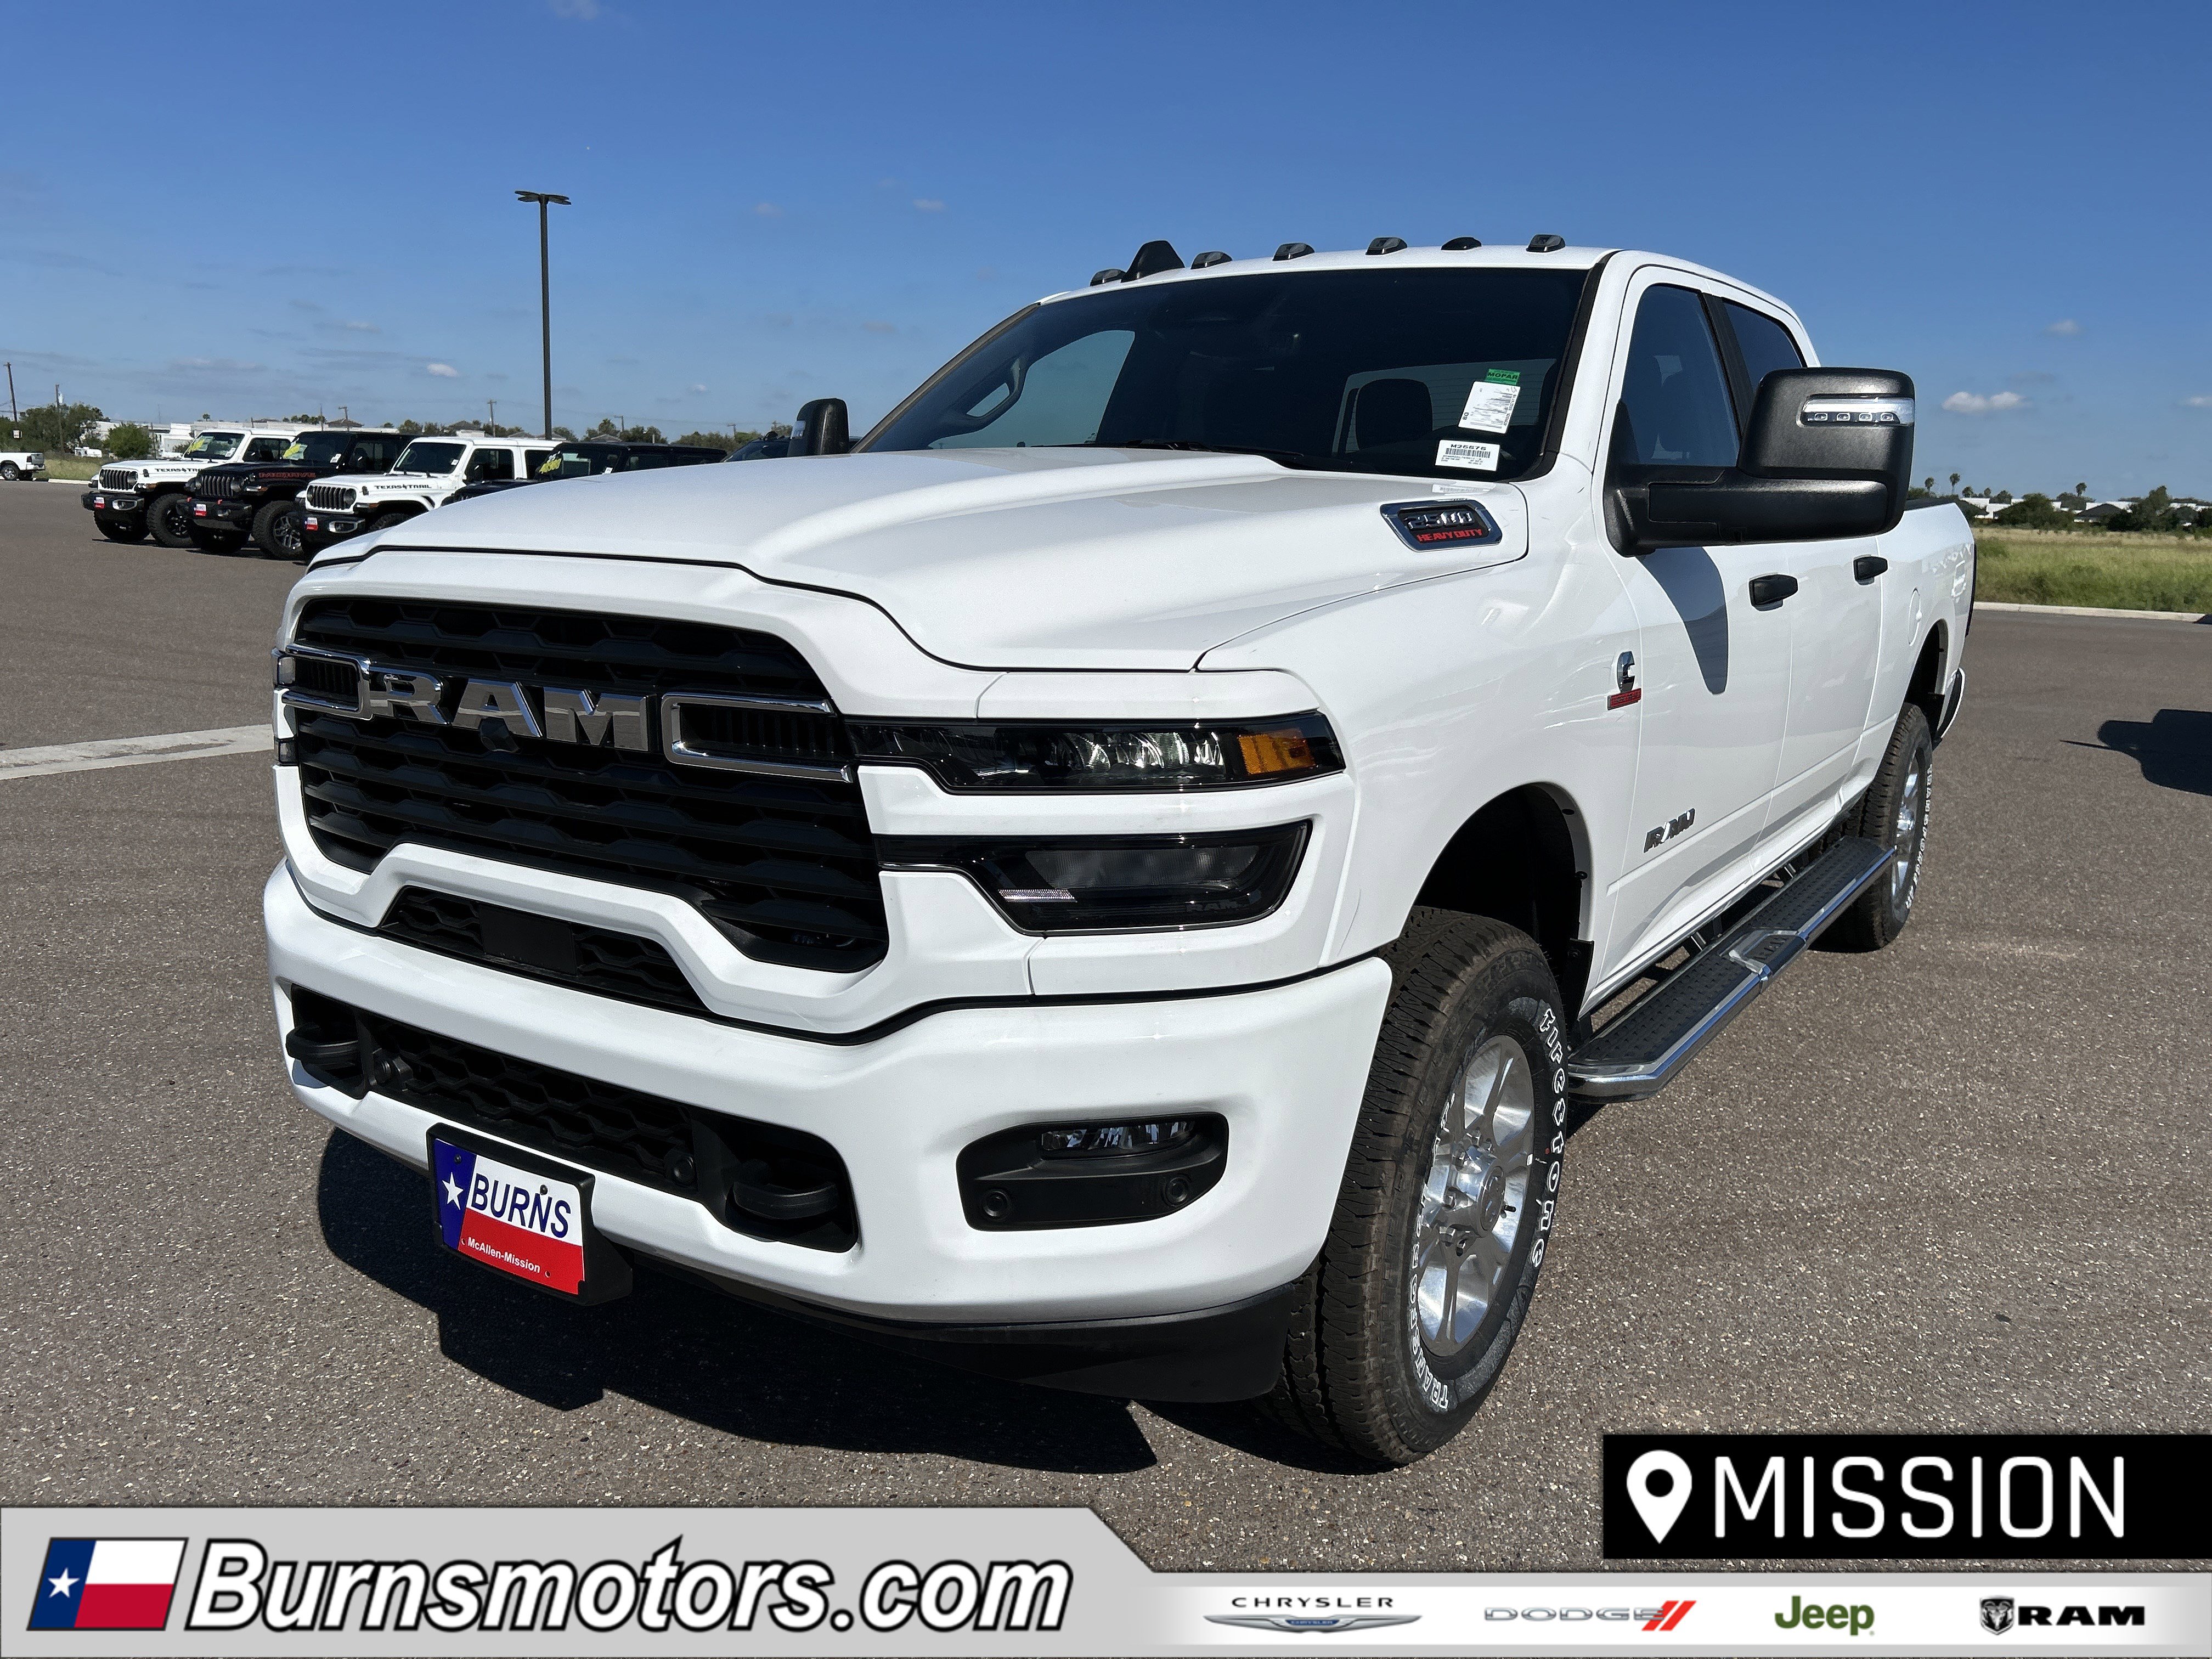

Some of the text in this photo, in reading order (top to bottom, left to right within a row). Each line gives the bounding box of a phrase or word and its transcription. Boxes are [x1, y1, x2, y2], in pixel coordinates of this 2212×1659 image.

[1416, 529, 1482, 543] HEAVY DUTY
[370, 665, 650, 751] RAM
[1643, 808, 1696, 853] RAM
[471, 1173, 571, 1238] BURNS
[468, 1237, 540, 1273] McAllen-Mission
